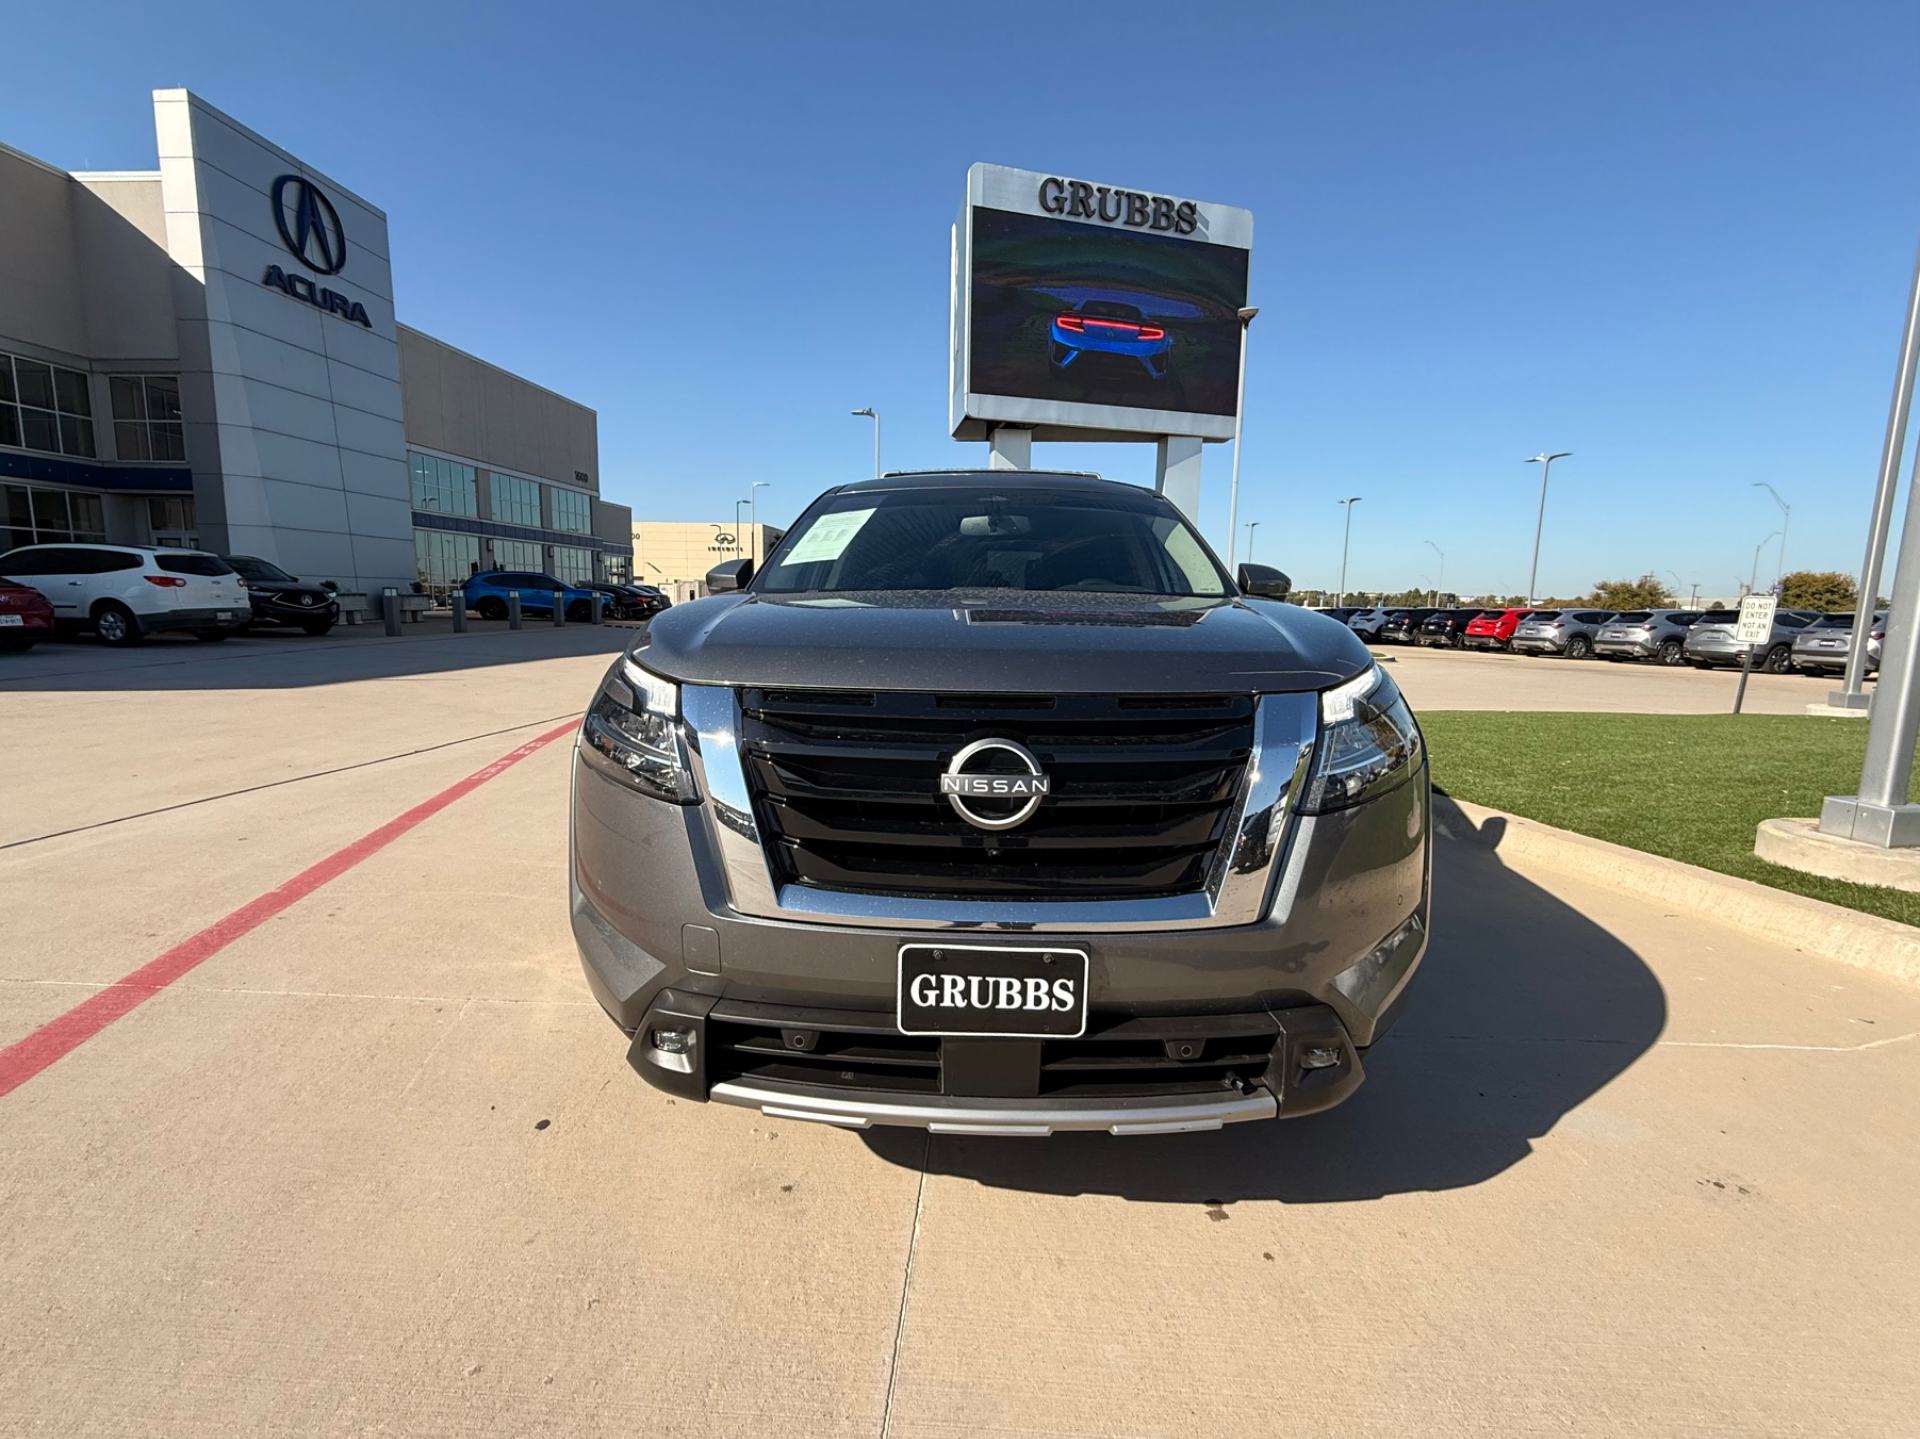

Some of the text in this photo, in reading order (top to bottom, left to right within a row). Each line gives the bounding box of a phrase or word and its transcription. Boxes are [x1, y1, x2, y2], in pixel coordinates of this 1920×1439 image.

[1039, 177, 1198, 235] GRUBBS
[262, 264, 373, 328] ACURA
[1758, 602, 1772, 610] NOT
[1745, 611, 1768, 619] ENTER
[1757, 622, 1767, 630] AN
[944, 778, 1048, 793] NISSAN
[910, 973, 1075, 1012] GRUBBS
